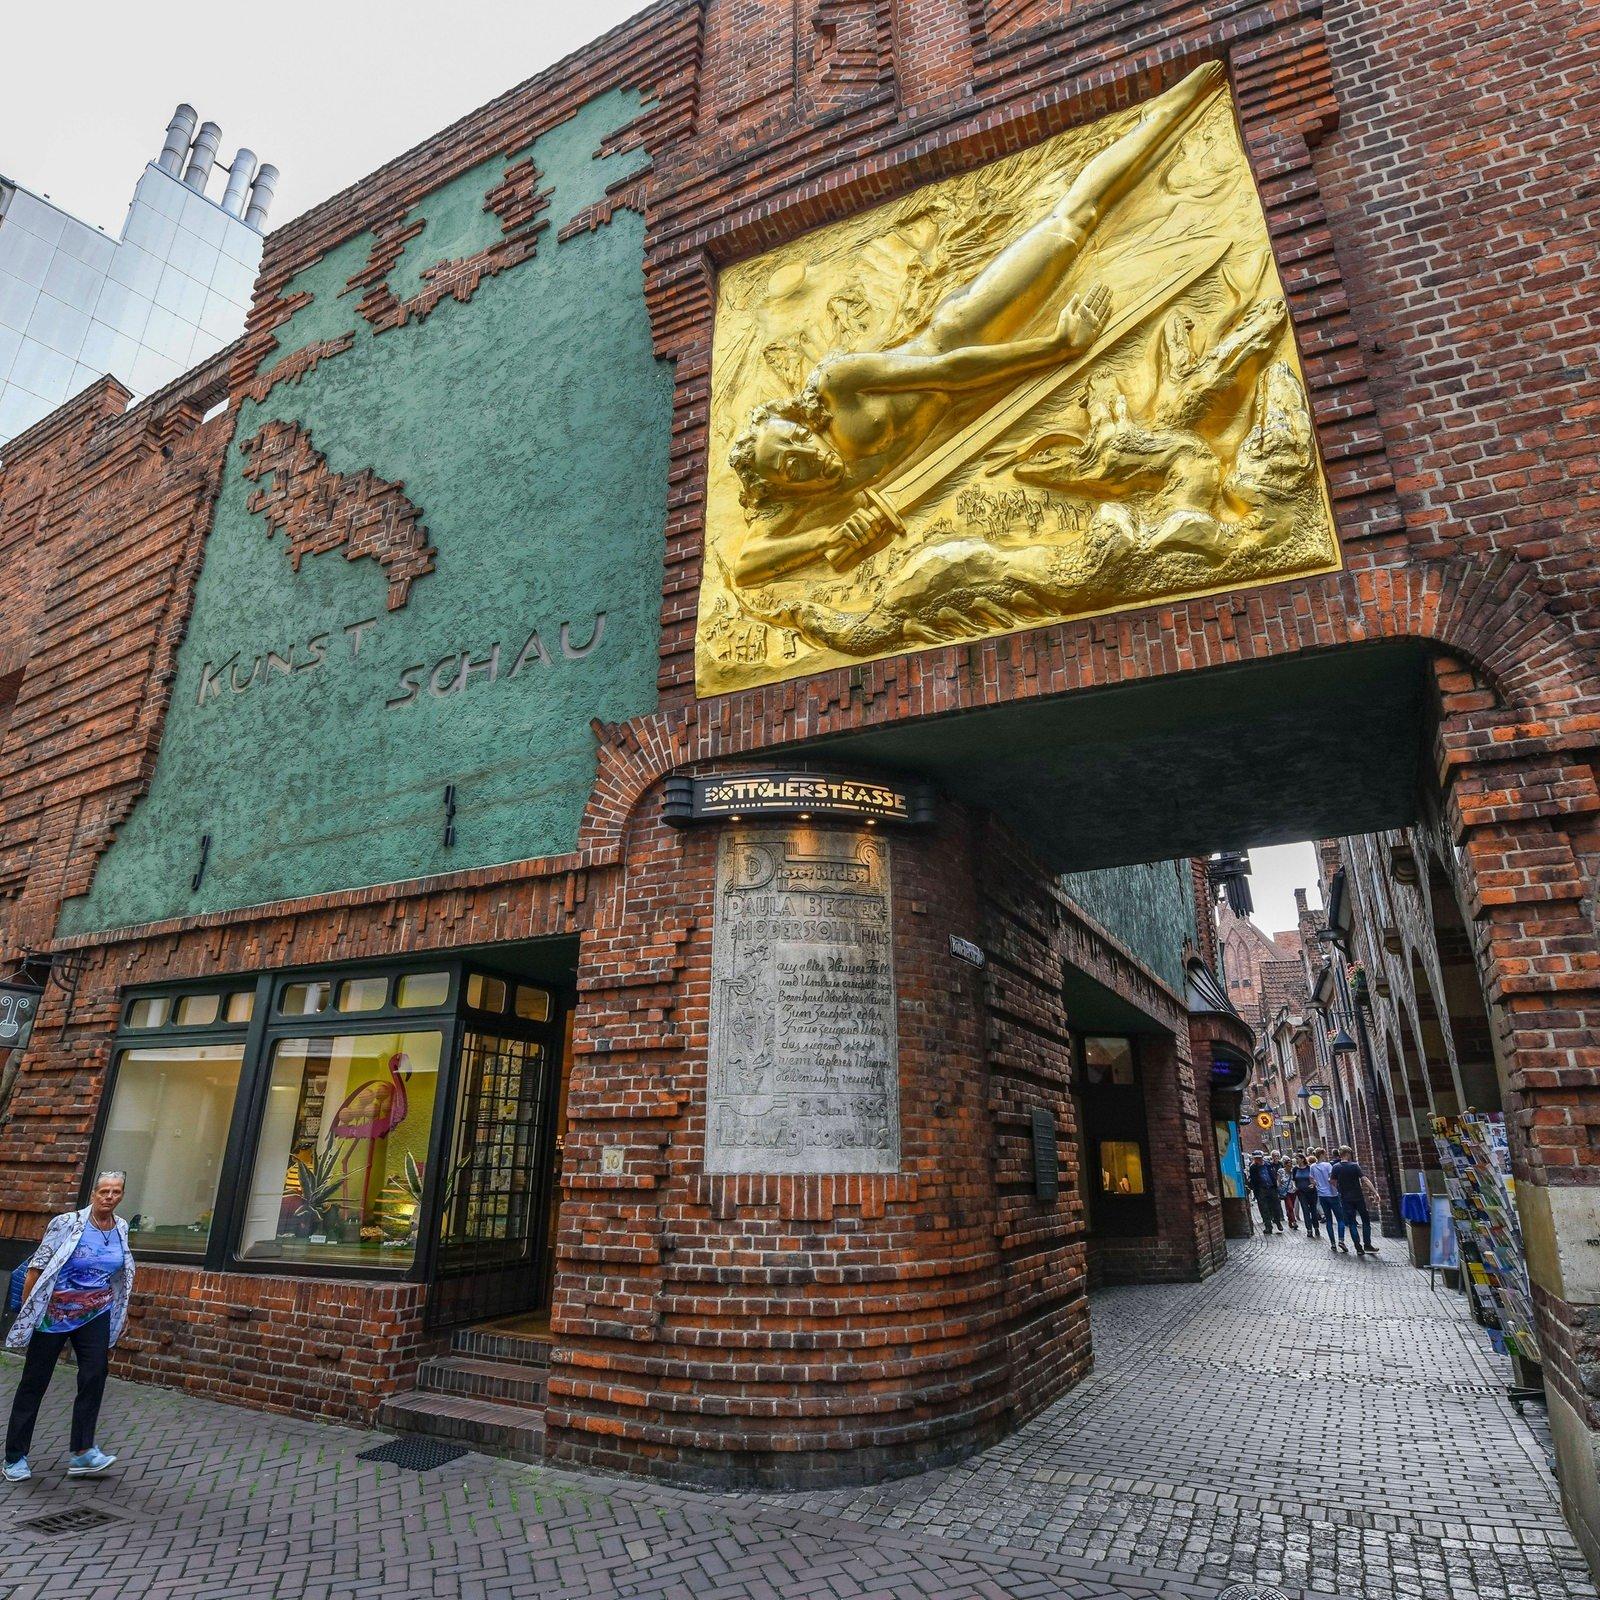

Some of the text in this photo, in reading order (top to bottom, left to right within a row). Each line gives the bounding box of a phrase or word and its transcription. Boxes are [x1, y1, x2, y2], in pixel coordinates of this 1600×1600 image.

[197, 617, 377, 706] KUNST
[385, 610, 607, 710] SCHAU
[726, 895, 797, 921] PAULA
[861, 928, 891, 945] HAUS
[779, 974, 798, 988] und
[850, 1097, 888, 1117] 1926
